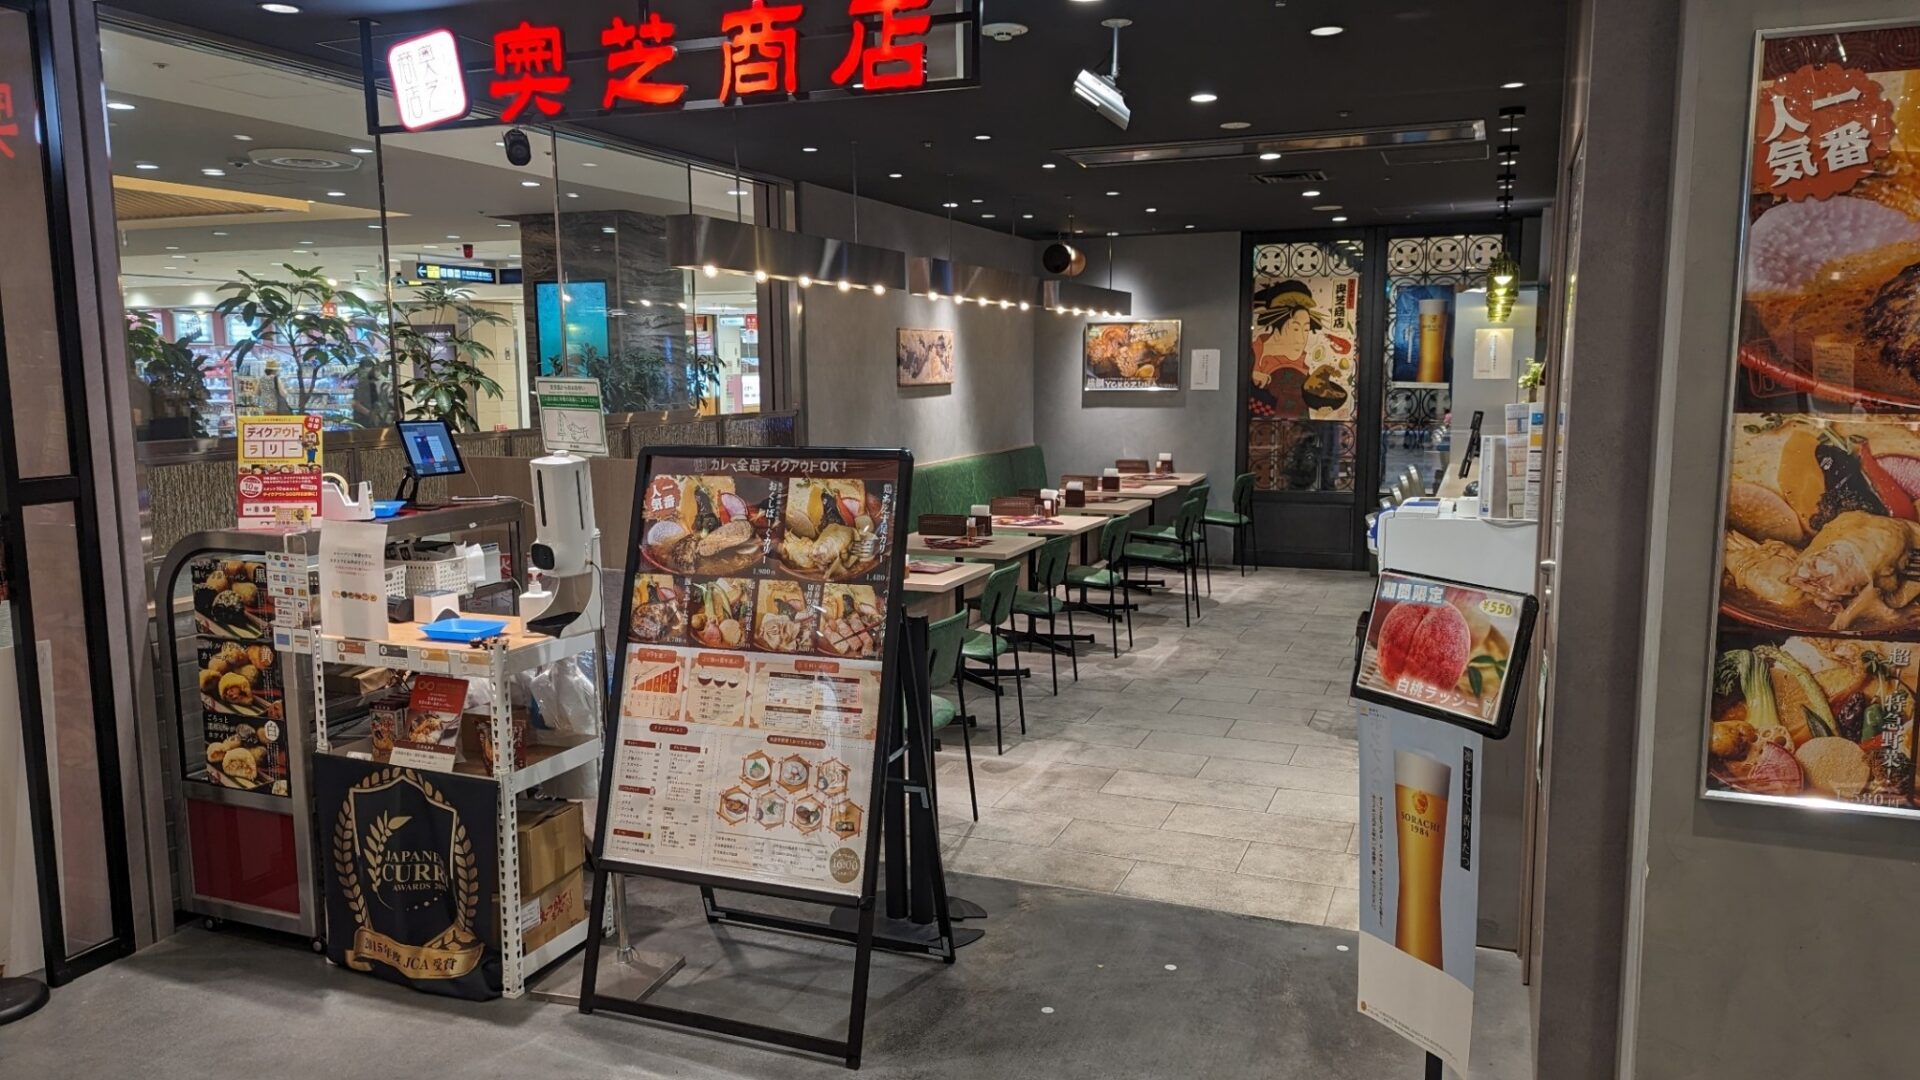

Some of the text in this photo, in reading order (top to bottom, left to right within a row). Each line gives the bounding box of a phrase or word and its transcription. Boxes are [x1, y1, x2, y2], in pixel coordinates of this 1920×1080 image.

[489, 0, 933, 122] 奥芝商店
[1761, 94, 1819, 188] 人気
[1811, 86, 1873, 174] 一番
[247, 427, 300, 438] テイクアウト
[1381, 581, 1445, 605] 期間限定
[1482, 599, 1513, 616] ¥550
[1395, 678, 1480, 709] 白桃ラッシー
[1400, 811, 1440, 833] SORACHI
[403, 956, 429, 970] JCA
